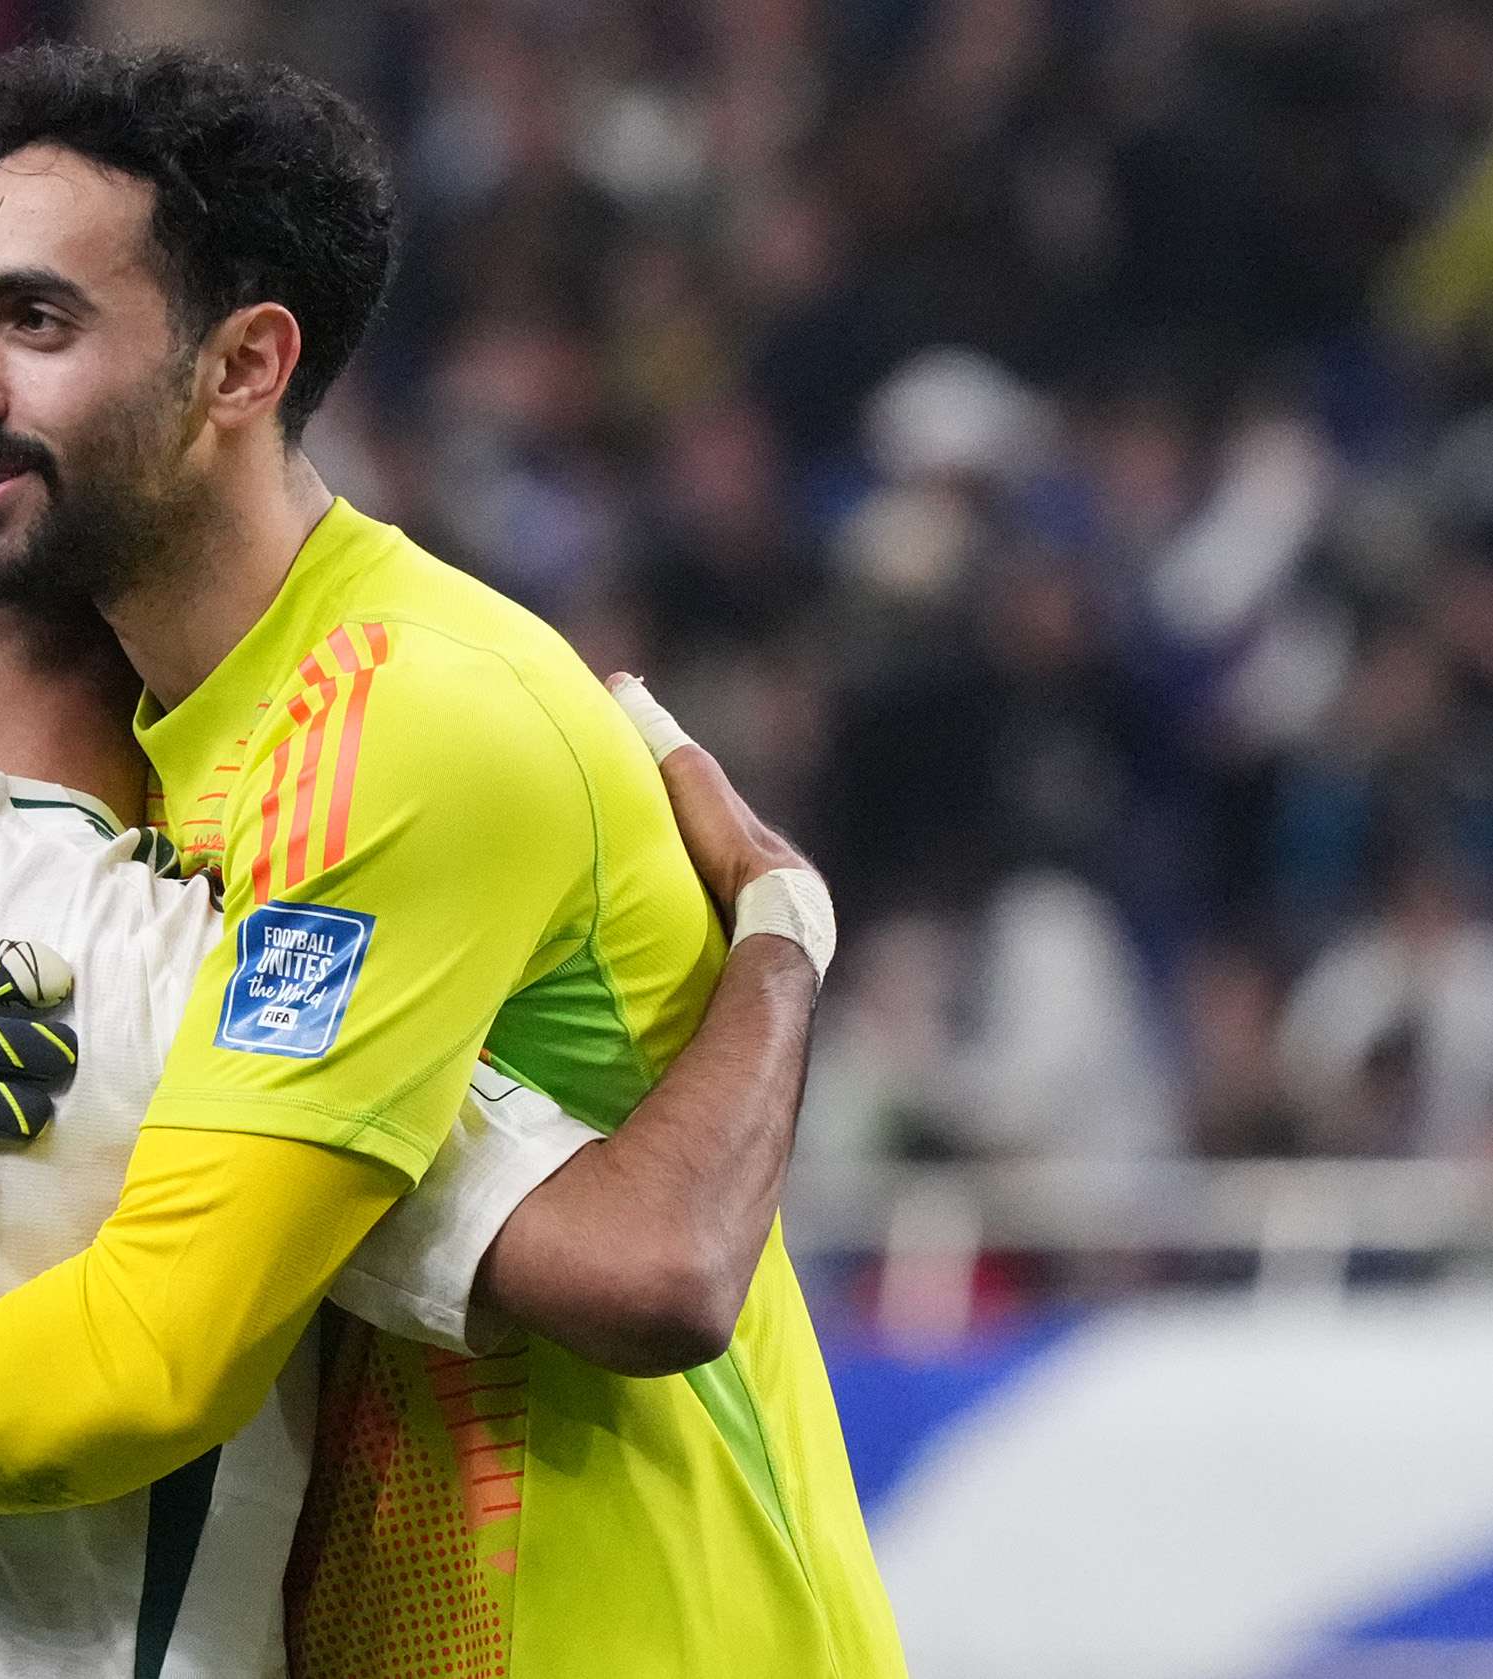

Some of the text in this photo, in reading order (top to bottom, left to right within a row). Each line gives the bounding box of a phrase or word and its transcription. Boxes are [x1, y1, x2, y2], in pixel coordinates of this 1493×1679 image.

[264, 926, 335, 957] FOOTBALL
[256, 947, 333, 983] UNITES
[247, 975, 328, 1010] the World
[264, 1010, 291, 1025] FIFA
